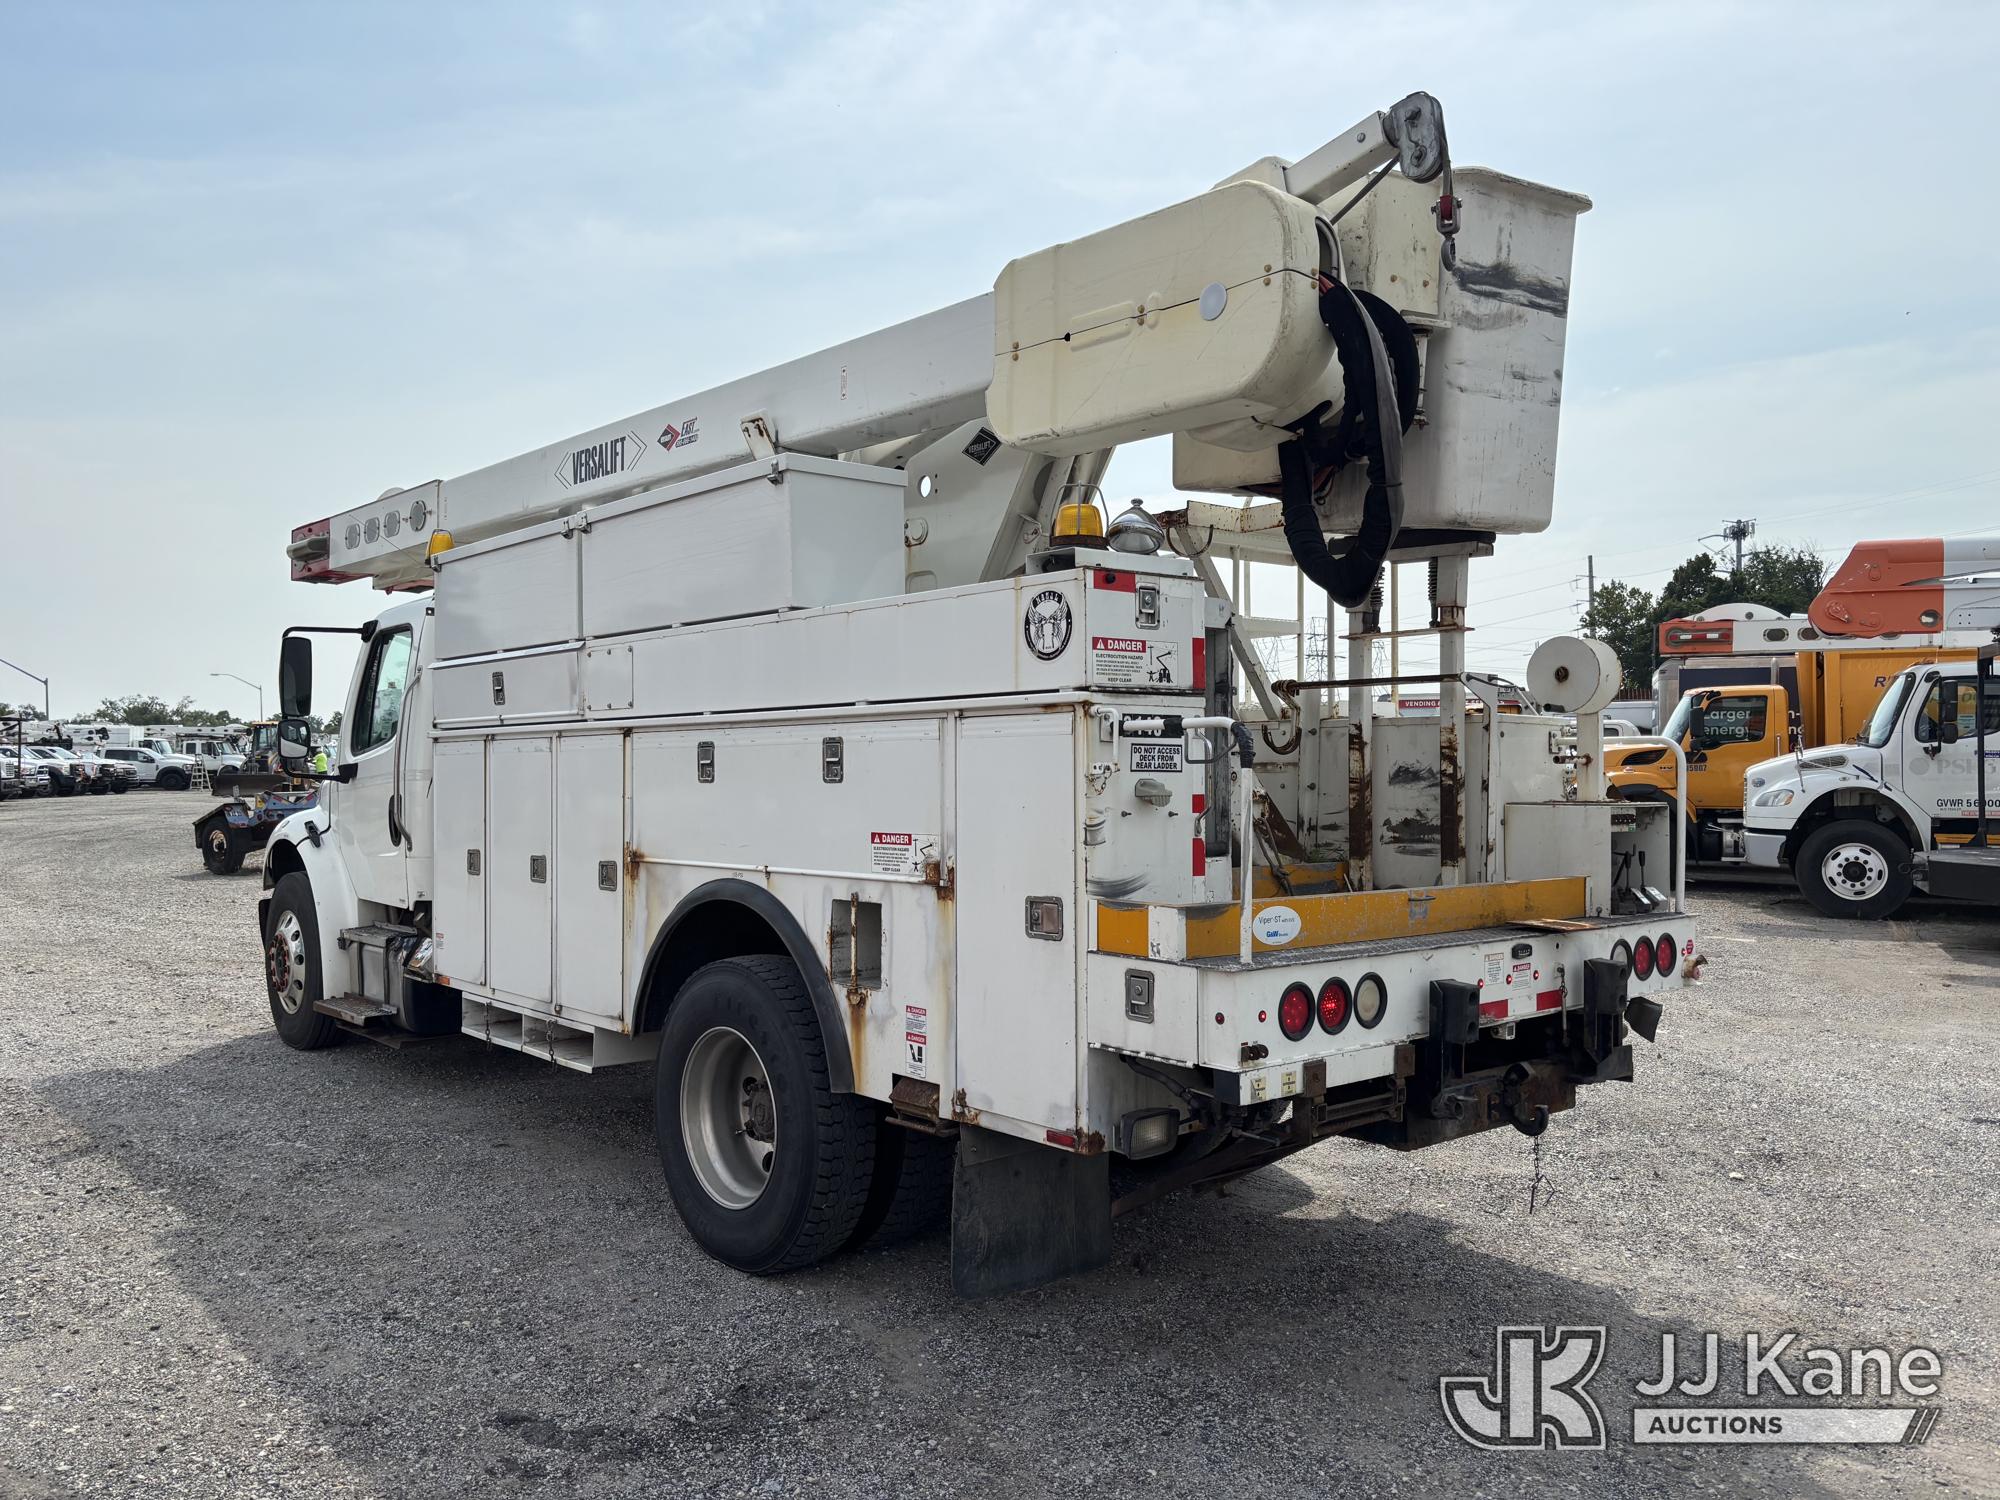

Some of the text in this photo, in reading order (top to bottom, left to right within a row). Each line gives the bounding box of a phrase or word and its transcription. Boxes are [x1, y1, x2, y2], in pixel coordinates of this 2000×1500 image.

[572, 436, 627, 485] VERSALIFT
[1107, 640, 1143, 651] DANGER
[1133, 746, 1143, 754] DO
[1157, 747, 1180, 755] ACCESS
[1154, 762, 1178, 770] LADDER
[1936, 798, 2000, 808] GVWR 5600
[881, 834, 909, 844] DANGER
